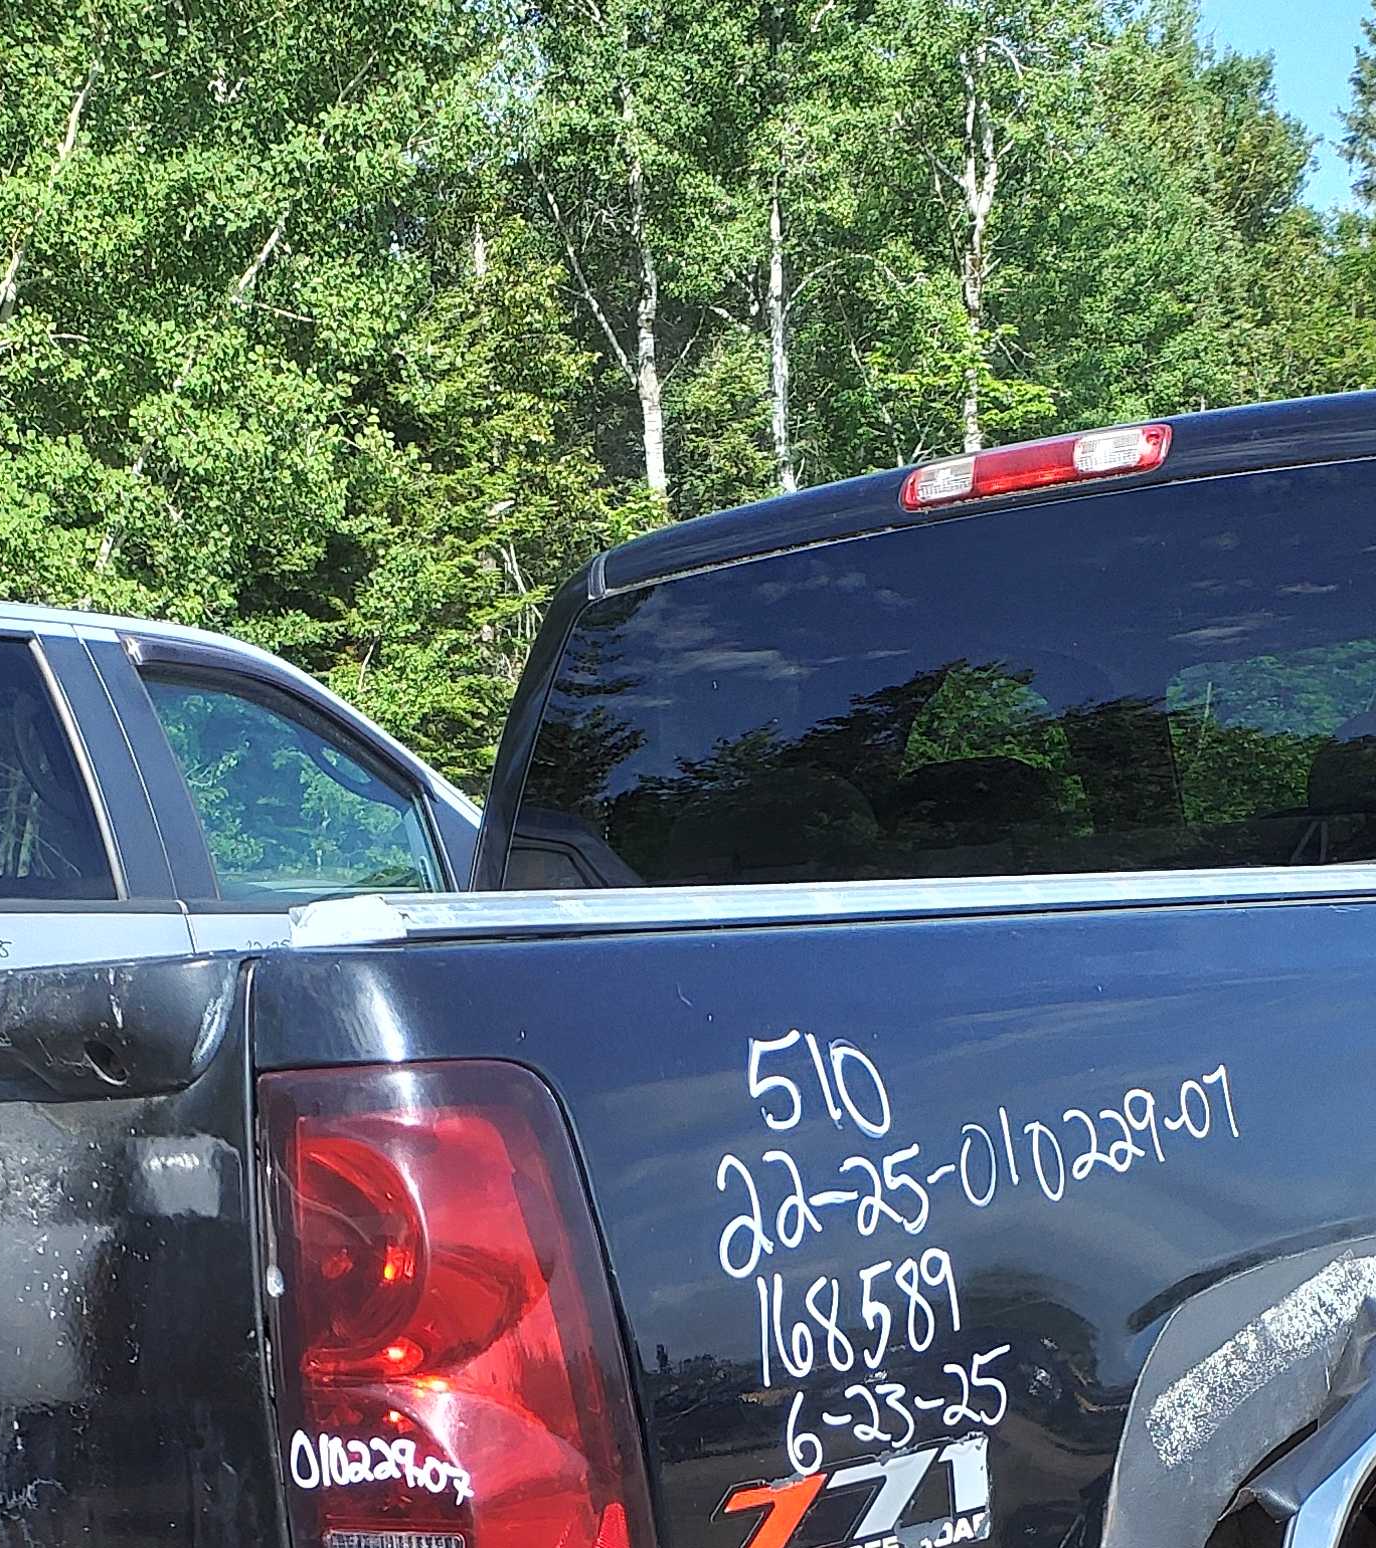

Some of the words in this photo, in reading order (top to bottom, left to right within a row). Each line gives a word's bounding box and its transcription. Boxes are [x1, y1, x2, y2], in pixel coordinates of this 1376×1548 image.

[747, 1029, 891, 1139] 510
[716, 1064, 1240, 1279] 22-25-010229-07
[755, 1248, 961, 1388] 168589
[786, 1344, 1012, 1475] 6-23-25
